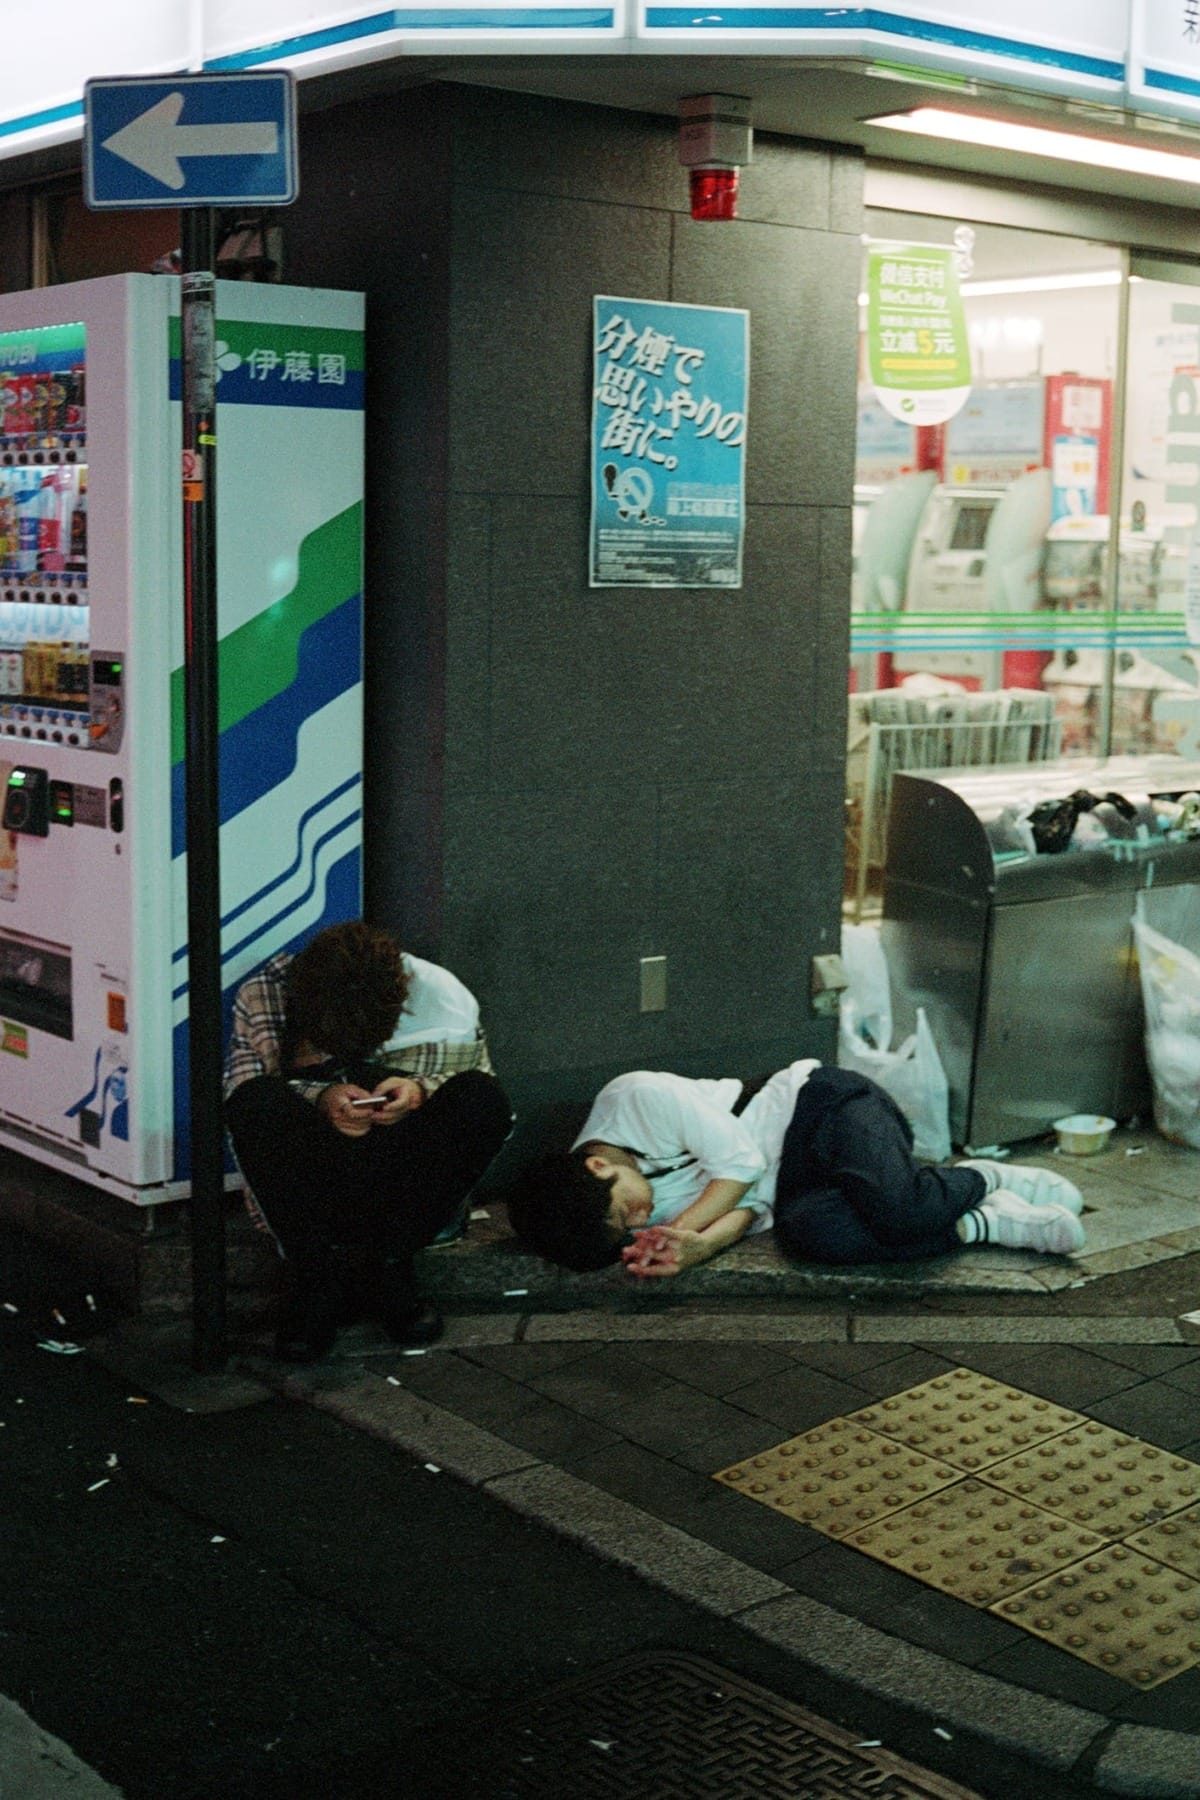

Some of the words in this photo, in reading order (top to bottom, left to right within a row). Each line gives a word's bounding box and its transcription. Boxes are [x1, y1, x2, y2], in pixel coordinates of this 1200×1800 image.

[246, 349, 346, 386] 伊藤園
[596, 314, 705, 385] 分煙で
[594, 361, 746, 447] 思いやりの
